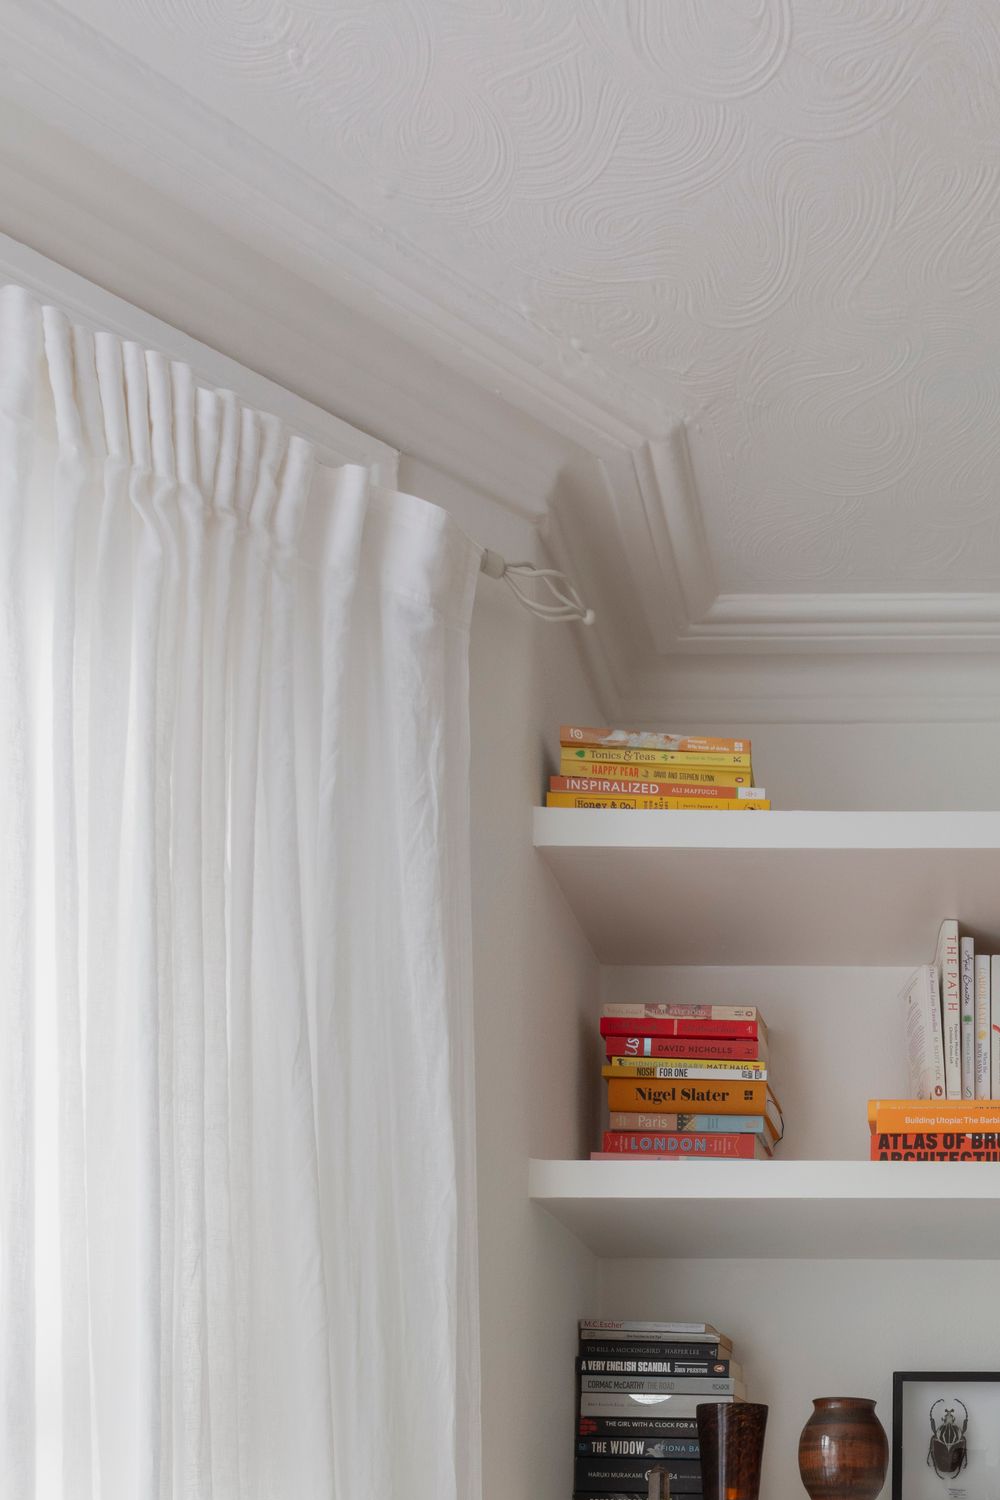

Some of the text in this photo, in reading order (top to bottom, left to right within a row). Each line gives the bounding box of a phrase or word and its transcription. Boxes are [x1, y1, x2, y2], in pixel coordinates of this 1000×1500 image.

[591, 750, 656, 761] Tonics & Teas
[592, 764, 639, 777] HAPPY PEAR
[566, 779, 660, 794] INSPIRALIZED
[947, 936, 958, 1011] THE PATH
[688, 1046, 733, 1054] NICHOLLS
[637, 1067, 688, 1077] NOSH FOR ONE
[635, 1087, 729, 1104] Nigel Slater
[638, 1115, 668, 1129] Paris
[905, 1116, 935, 1126] Building
[936, 1116, 963, 1125] Utopia:
[964, 1116, 979, 1124] The
[631, 1136, 706, 1152] LONDON
[879, 1133, 938, 1150] ATLAS
[943, 1133, 968, 1150] OF
[584, 1320, 624, 1329] M.C.Escher
[581, 1361, 671, 1373] A VERY ENGLISH SCANDAL
[588, 1381, 645, 1390] CORMAC McCARTHY
[592, 1441, 645, 1455] THE WIDOW
[612, 1471, 643, 1479] MURAKAMI
